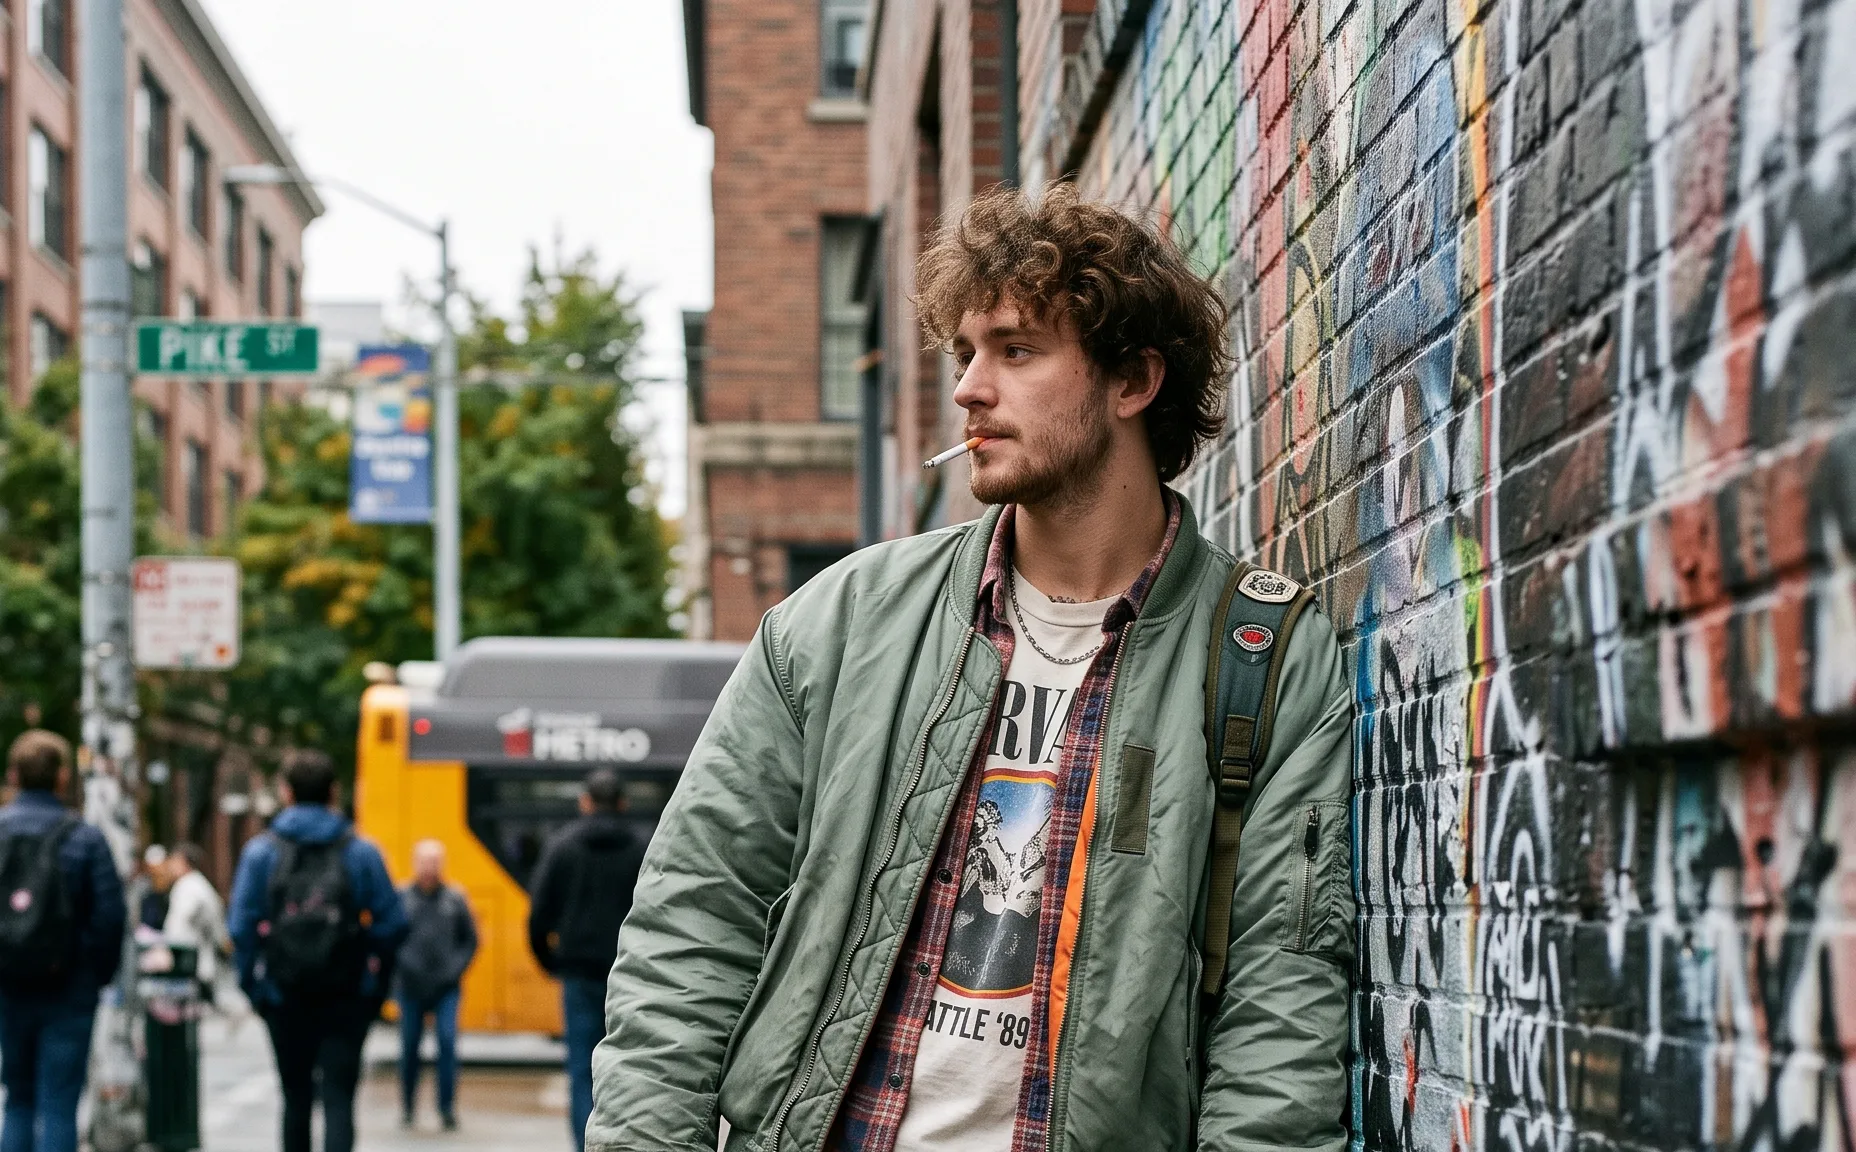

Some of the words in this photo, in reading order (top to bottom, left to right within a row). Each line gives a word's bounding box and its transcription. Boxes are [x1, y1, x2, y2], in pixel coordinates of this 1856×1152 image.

[160, 325, 249, 372] PIKE
[265, 326, 297, 356] ST
[533, 727, 651, 762] METRO
